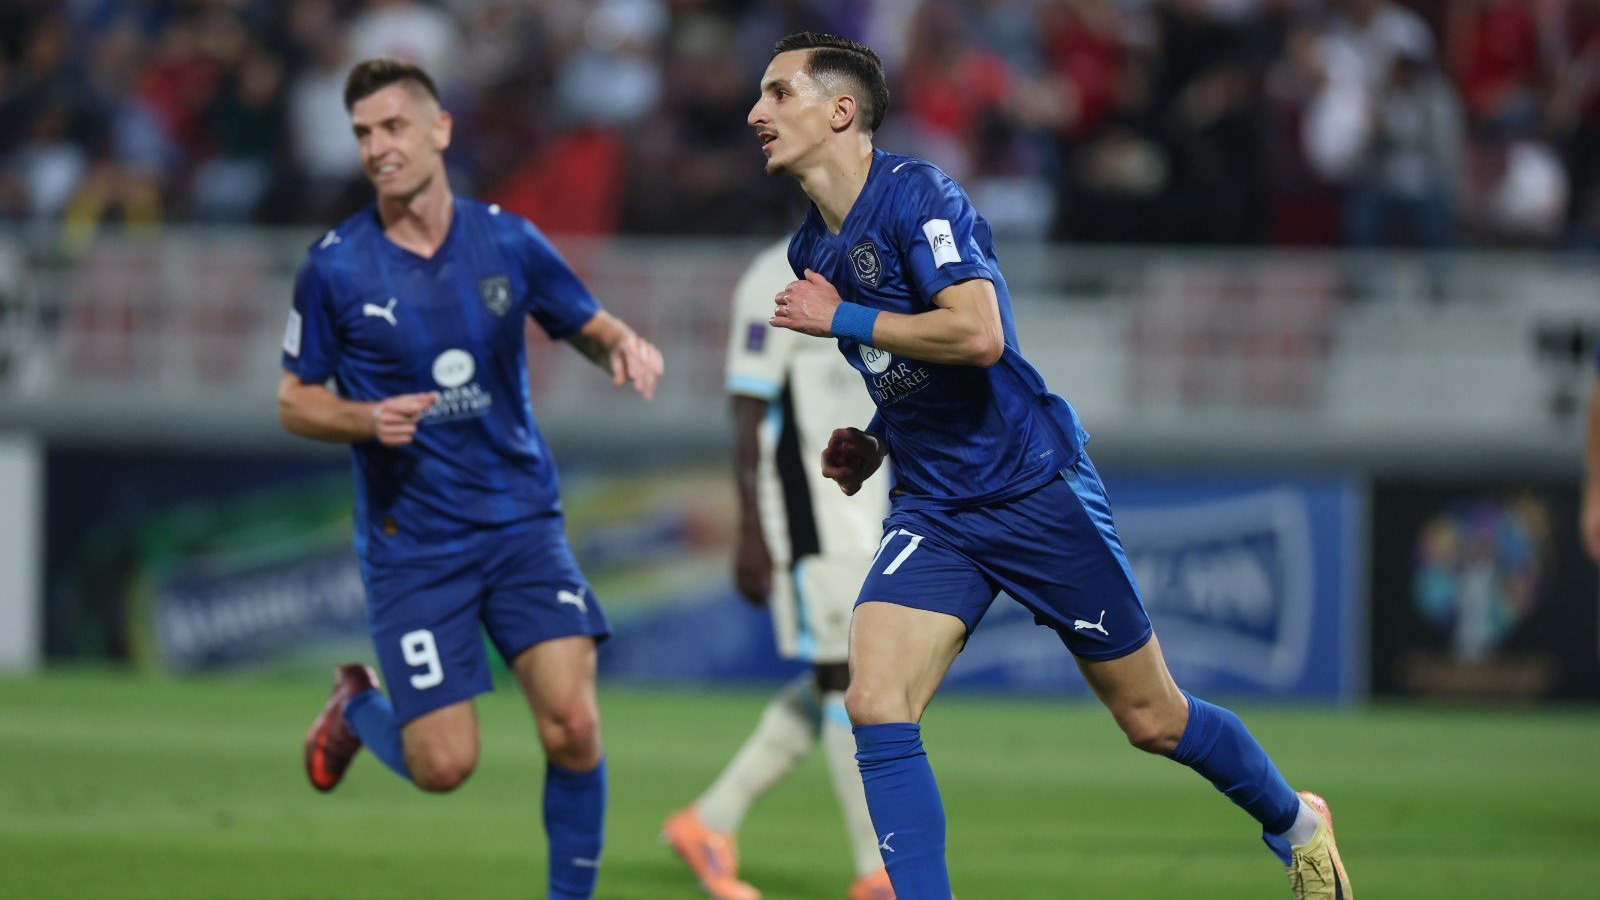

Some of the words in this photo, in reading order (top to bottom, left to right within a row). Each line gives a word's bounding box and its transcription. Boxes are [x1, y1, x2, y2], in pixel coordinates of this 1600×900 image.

[933, 233, 952, 250] AFC
[873, 362, 911, 389] QTAR
[400, 628, 445, 690] 9
